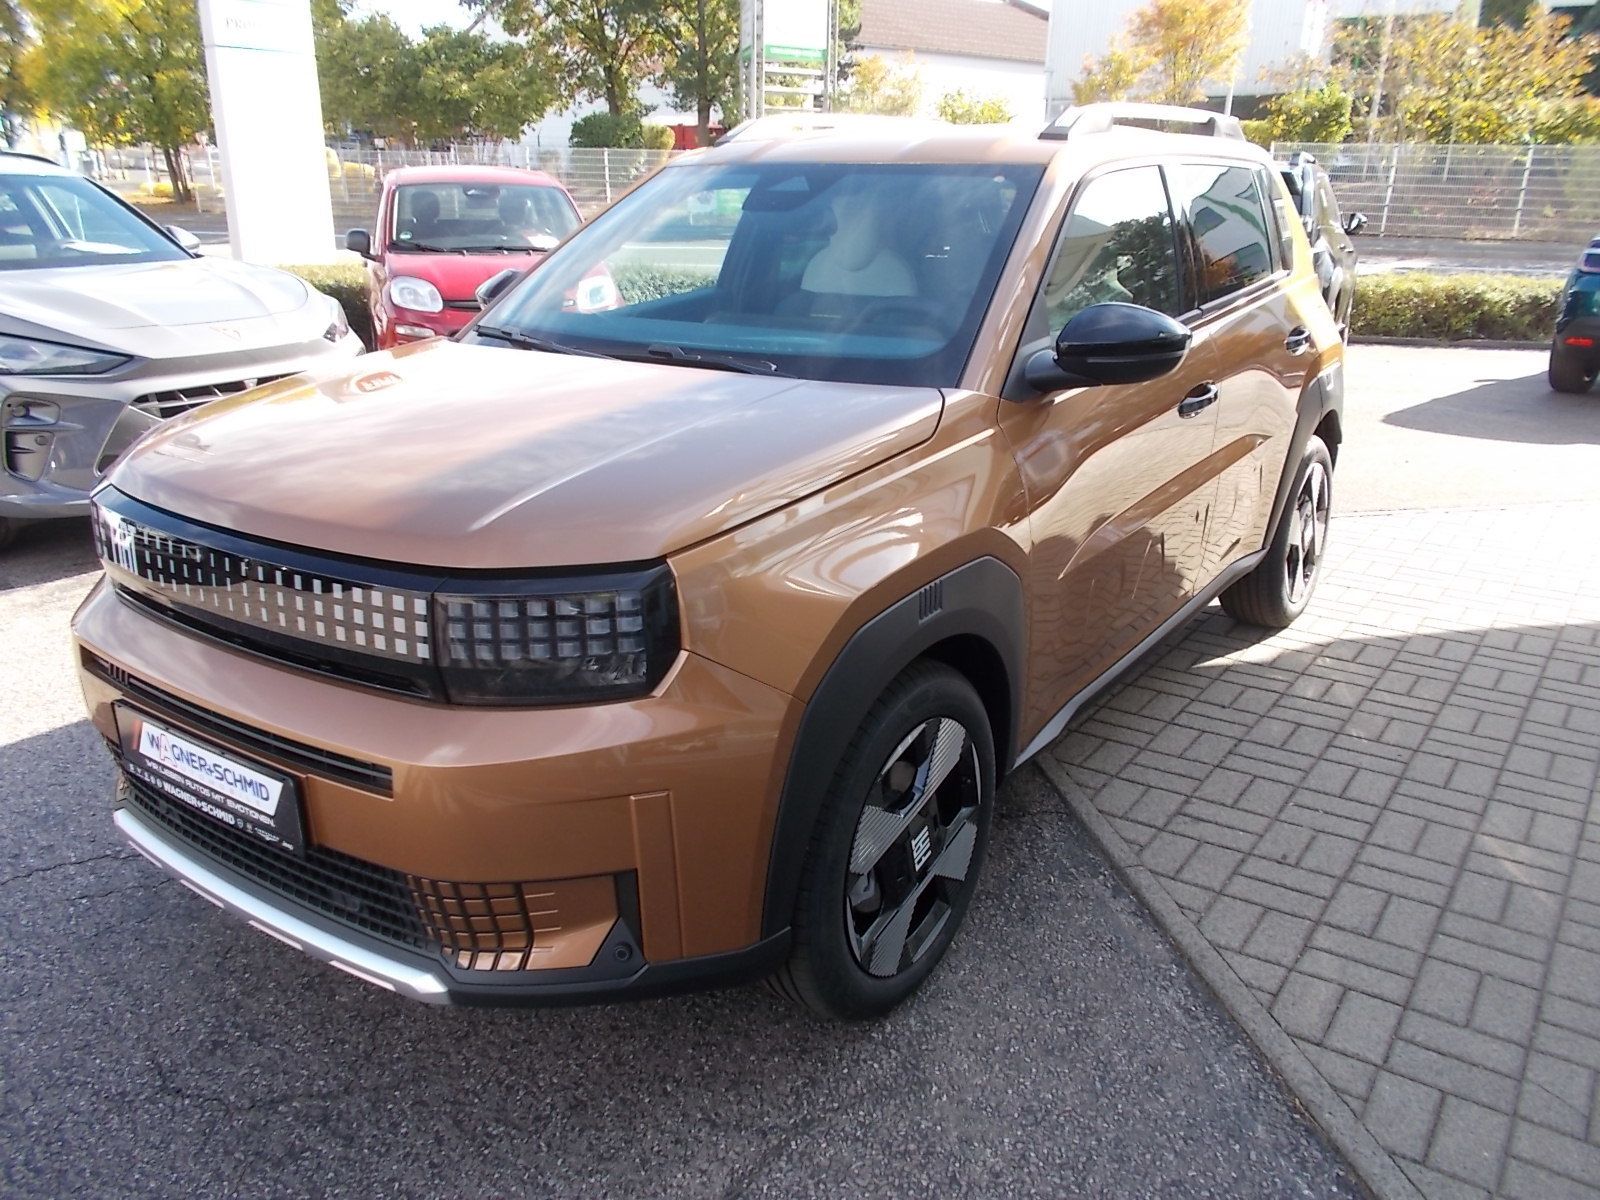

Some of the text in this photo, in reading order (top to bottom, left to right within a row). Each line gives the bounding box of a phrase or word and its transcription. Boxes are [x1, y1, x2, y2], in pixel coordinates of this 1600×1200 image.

[147, 733, 270, 802] WAGNER+SCHMID
[163, 782, 235, 825] WAGNER+SCHMID
[185, 779, 211, 797] AUTOS
[212, 791, 226, 804] MIT
[911, 825, 932, 872] FIAT
